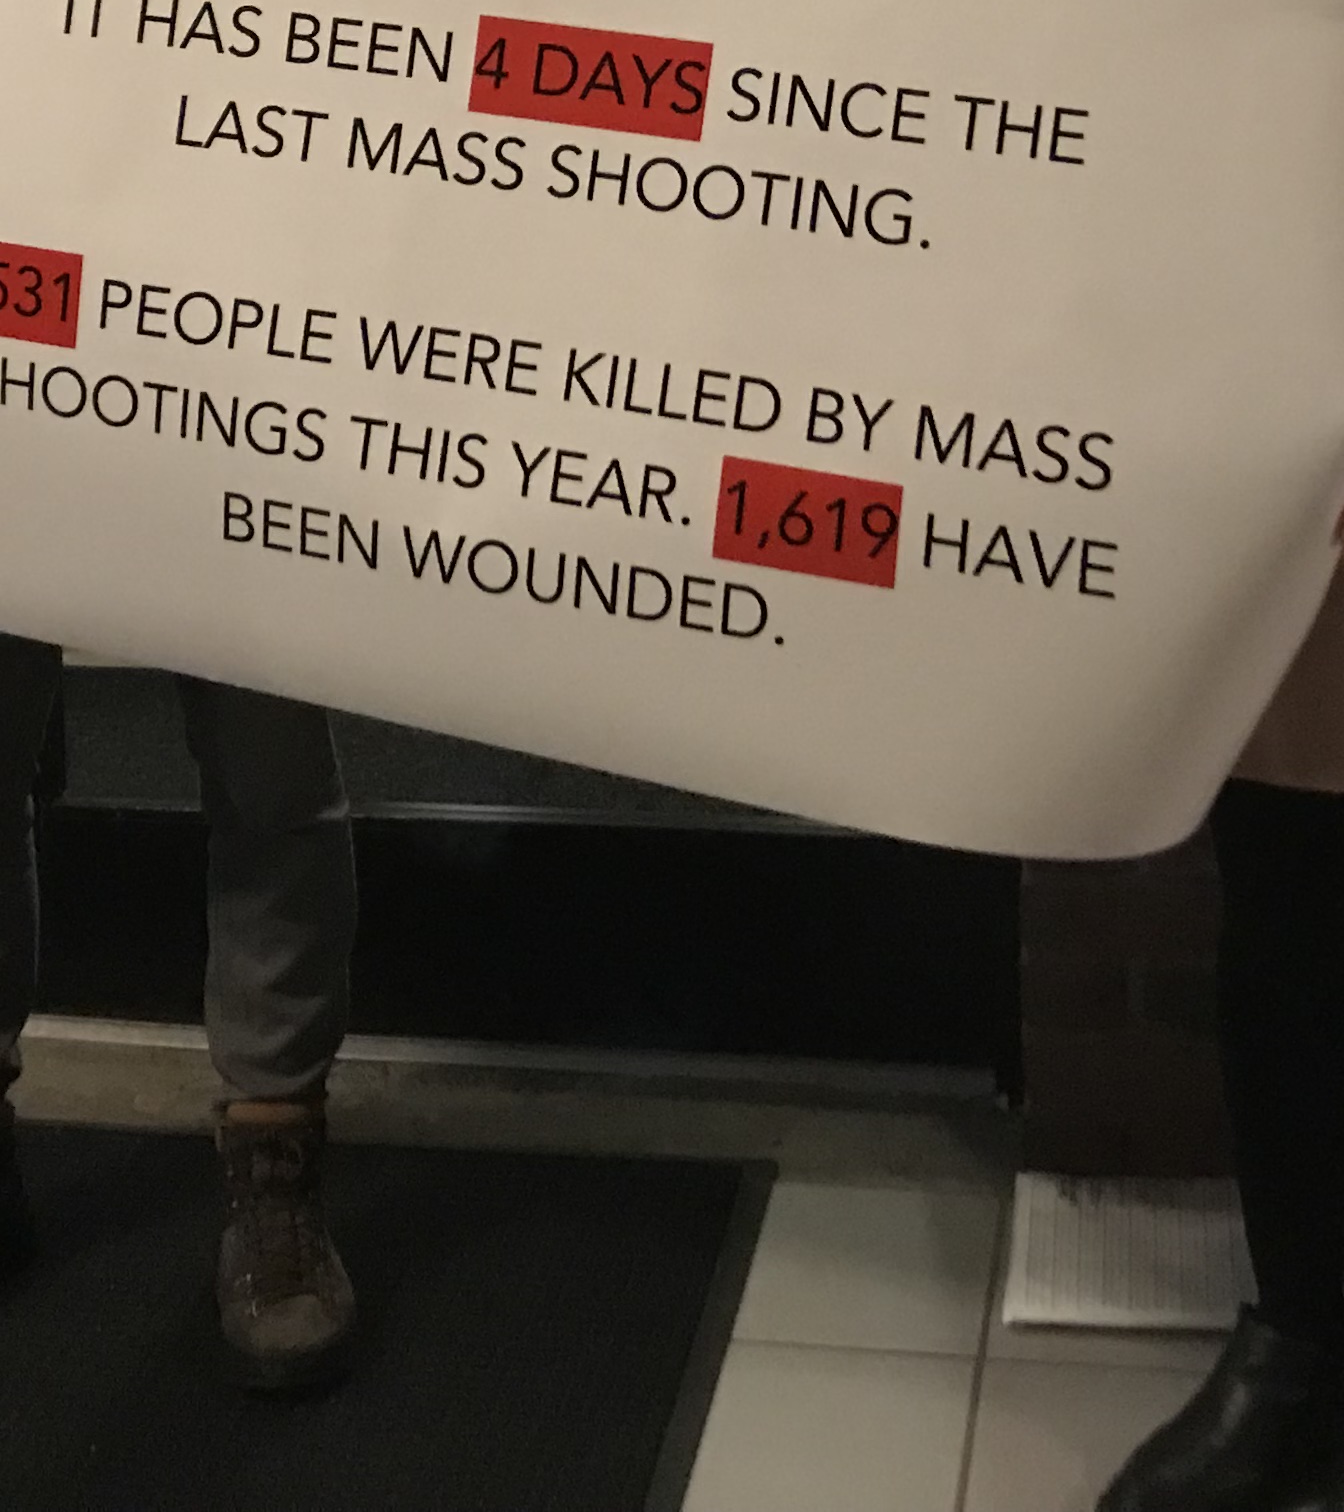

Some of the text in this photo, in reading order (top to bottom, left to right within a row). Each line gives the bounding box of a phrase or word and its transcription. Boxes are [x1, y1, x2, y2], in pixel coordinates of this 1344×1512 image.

[285, 11, 454, 83] BEEN
[474, 37, 509, 90] 4
[532, 43, 707, 116] DAYS
[726, 67, 931, 145] SINCE
[954, 94, 1090, 166] THE
[175, 94, 930, 250] LAST MASS SHOOTING.
[99, 278, 338, 365] PEOPLE
[359, 316, 543, 397] WERE
[563, 347, 782, 433] KILLED
[805, 386, 895, 453] BY
[914, 404, 1114, 492] MASS
[222, 491, 785, 646] BEEN WOUNDED.
[349, 415, 489, 489] THIS
[511, 440, 691, 527] YEAR.
[726, 479, 900, 559] 1,619
[922, 512, 1119, 600] HAVE
